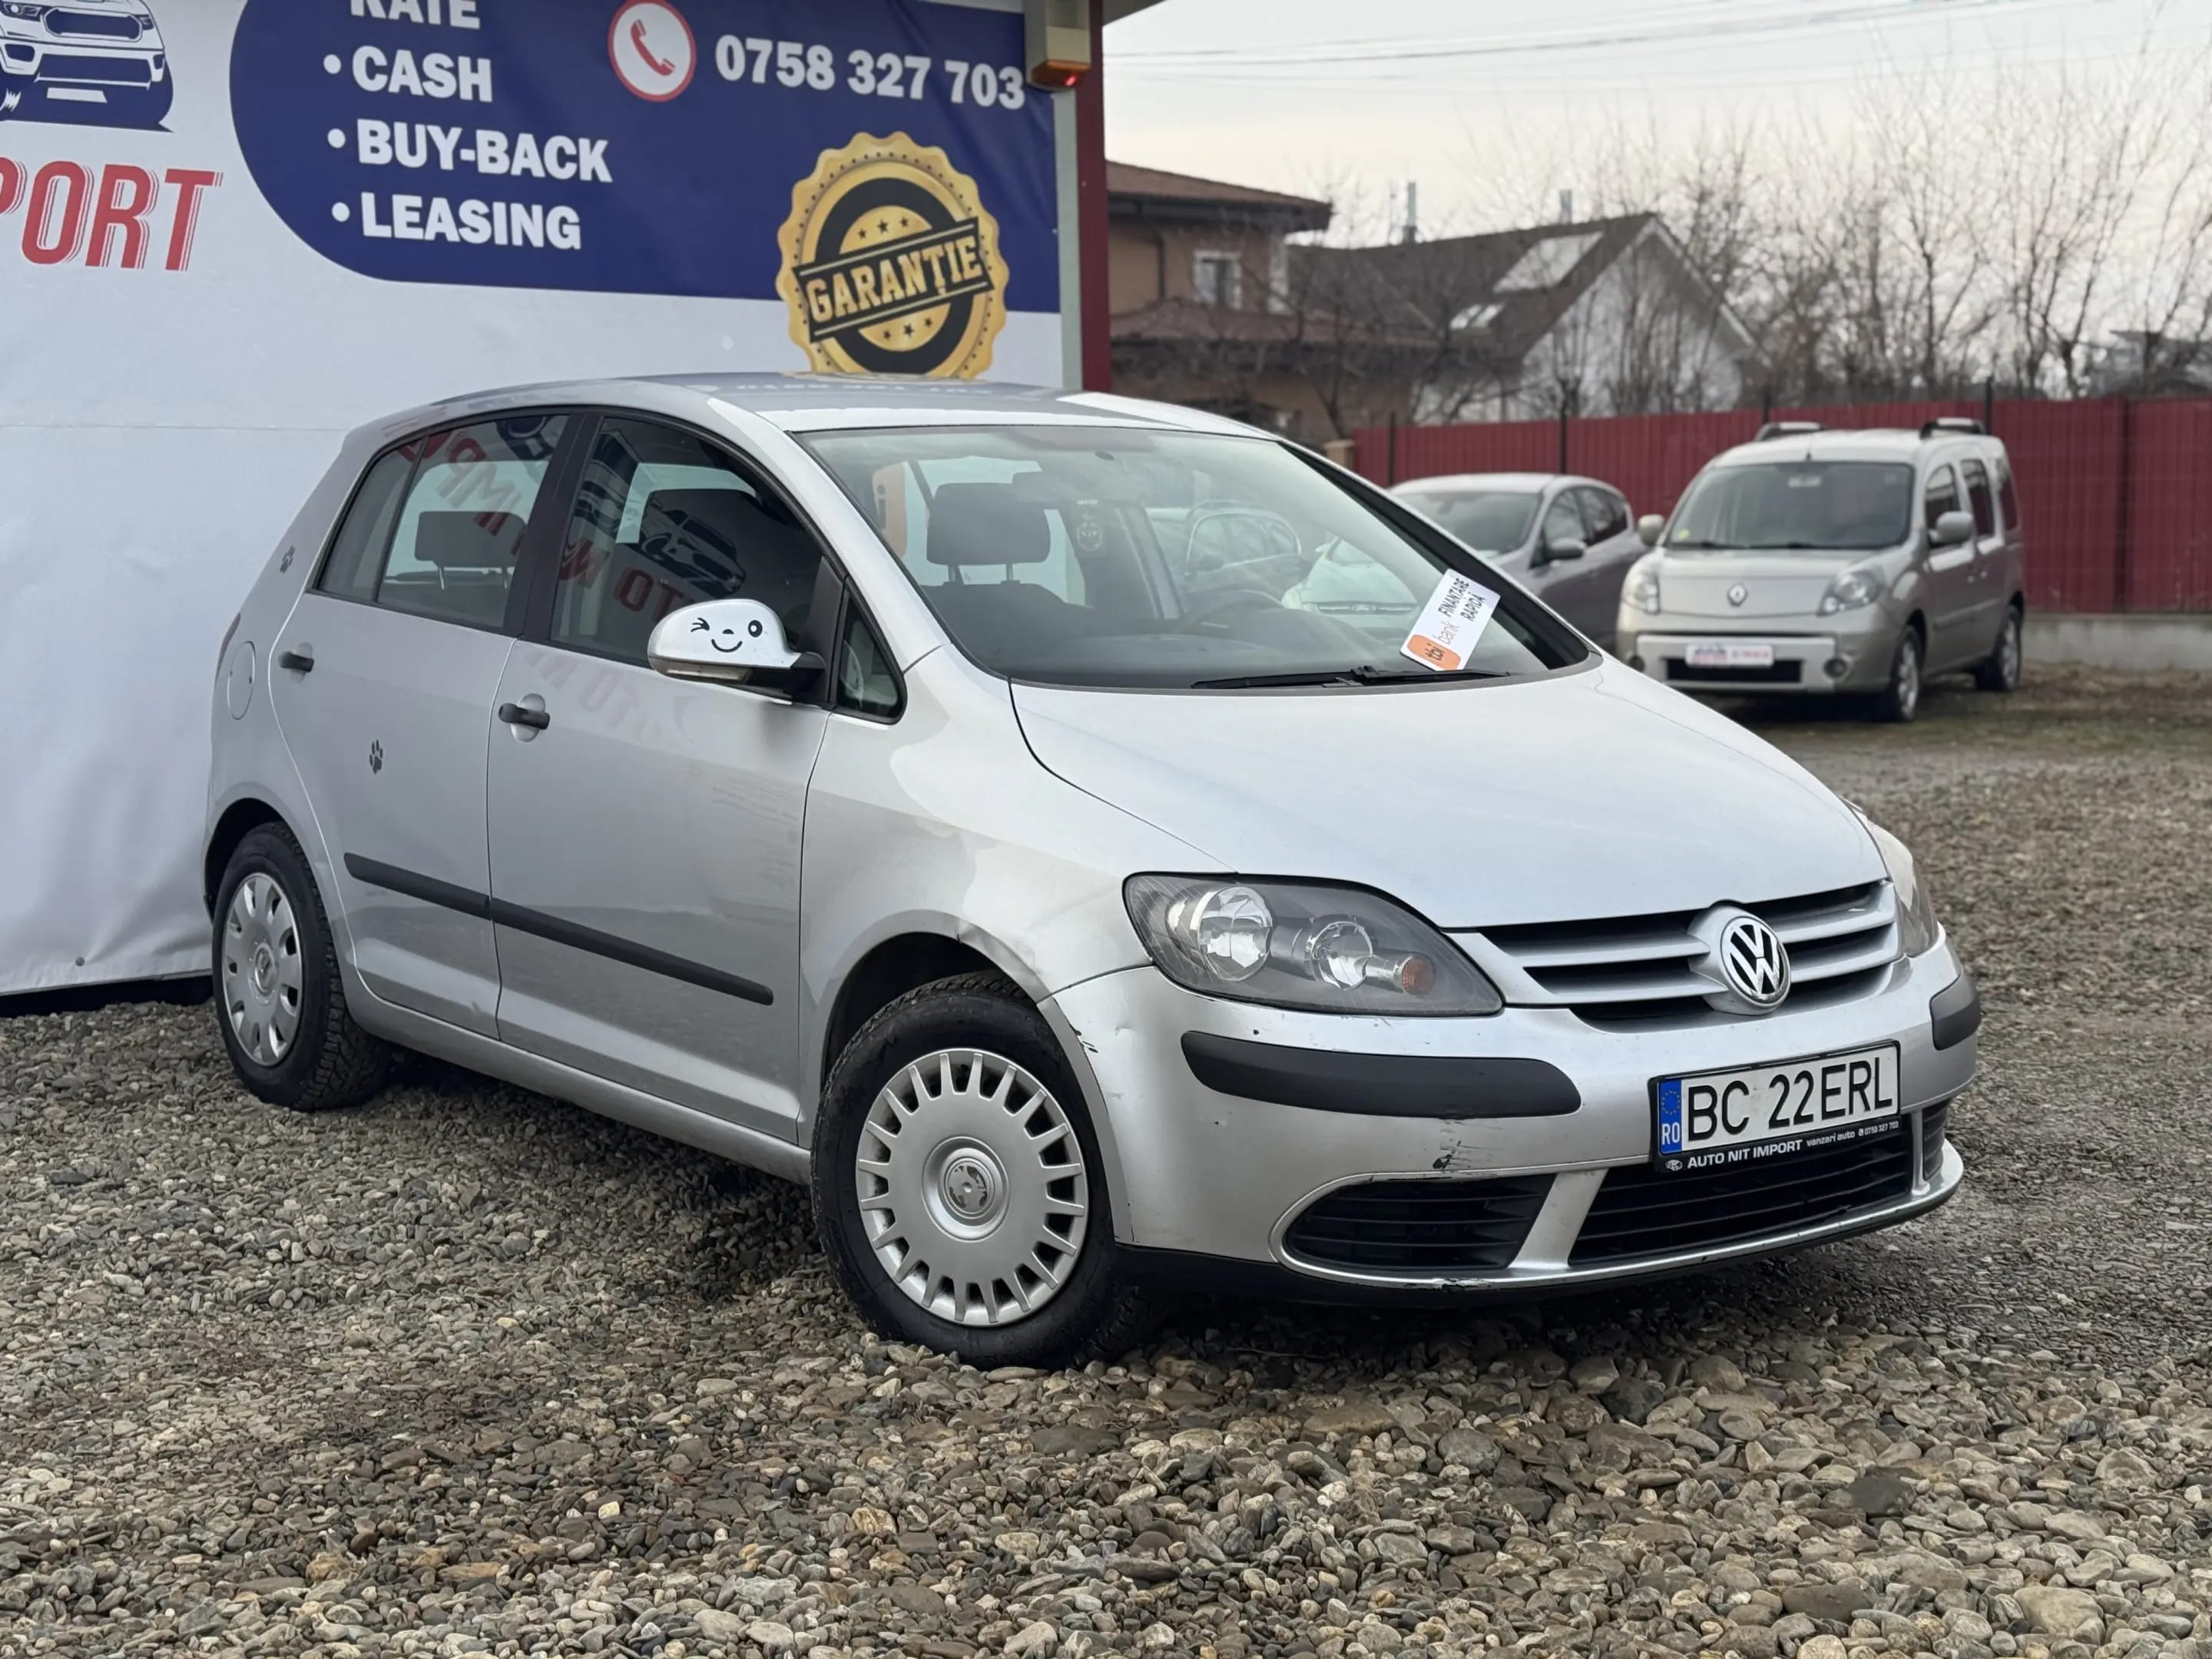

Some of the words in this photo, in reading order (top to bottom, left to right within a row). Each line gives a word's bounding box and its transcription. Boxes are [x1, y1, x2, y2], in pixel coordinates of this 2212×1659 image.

[353, 45, 492, 102] CASH
[715, 34, 836, 90] 0758
[847, 50, 931, 99] 327
[945, 61, 1025, 109] 703
[356, 118, 613, 183] BUY-BACK
[361, 192, 582, 250] LEASING
[1688, 1080, 1750, 1143] BC
[1768, 1057, 1892, 1129] 22ERL
[1661, 1122, 1680, 1145] RO
[1687, 1152, 1725, 1169] AUTO
[1728, 1148, 1750, 1162] NIT
[1753, 1139, 1803, 1158] IMPORT
[1806, 1132, 1836, 1147] vanzari
[1837, 1130, 1856, 1141] auto
